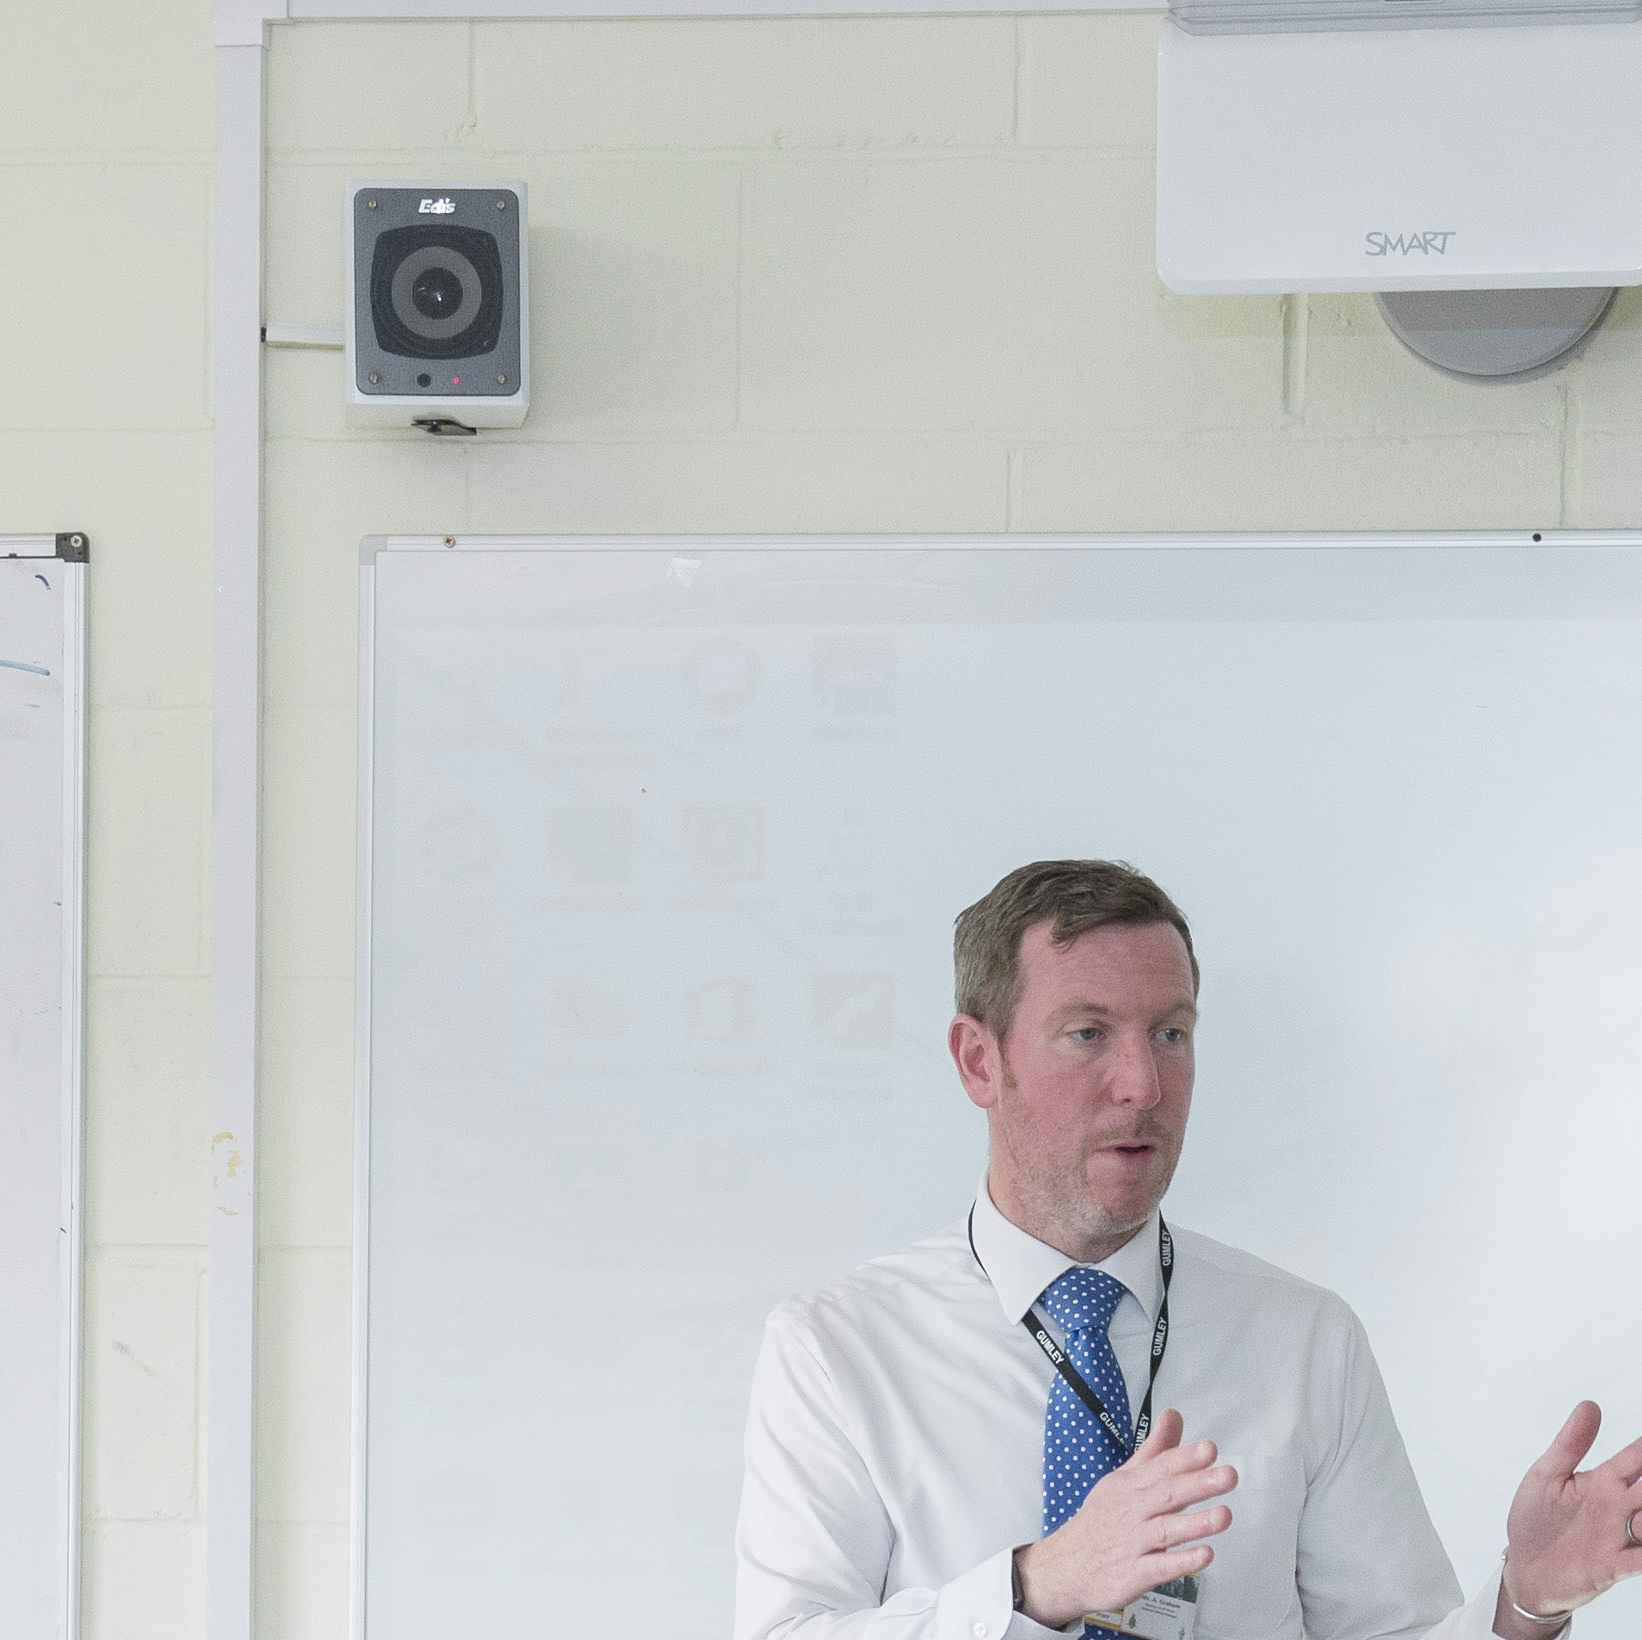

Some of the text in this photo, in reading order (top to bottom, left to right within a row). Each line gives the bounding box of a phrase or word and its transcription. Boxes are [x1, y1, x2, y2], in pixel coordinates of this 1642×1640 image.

[418, 197, 456, 214] Edis
[1364, 231, 1456, 256] SMART
[1162, 1229, 1171, 1267] GUMLEY
[1036, 1330, 1065, 1364] GUMLEY
[1152, 1316, 1168, 1357] GUMLEY
